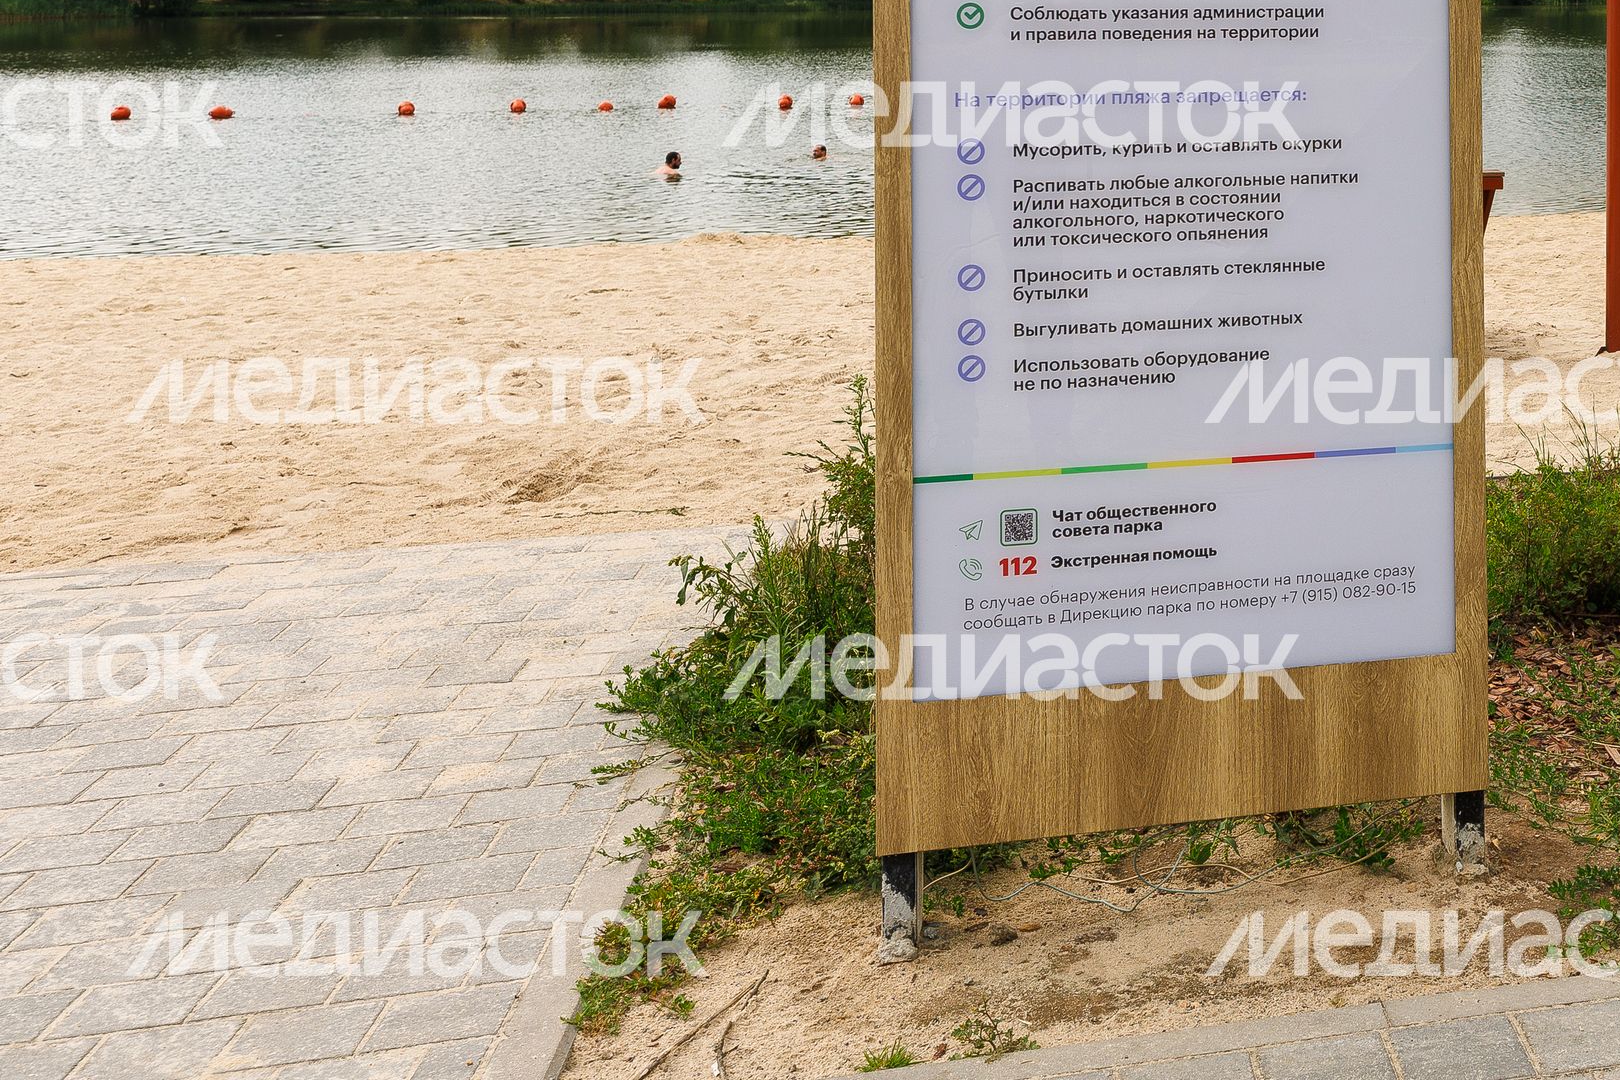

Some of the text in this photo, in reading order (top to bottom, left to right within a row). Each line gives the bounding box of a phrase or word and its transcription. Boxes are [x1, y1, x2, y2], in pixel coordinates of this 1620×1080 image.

[1010, 5, 1325, 23] Соблюдать указания администрации
[1010, 27, 1319, 44] и правила поведения на территории
[954, 89, 1307, 111] На территории пляжа запрещается:
[1013, 138, 1342, 161] Мусорить, курить и оставлять окурки
[1013, 172, 1359, 194] Распивать любые алкогольные напитки
[1013, 192, 1281, 214] и/или находиться в состоянии
[1012, 209, 1285, 230] алкогольного, наркотического
[1013, 227, 1268, 248] или токсического опьянения
[1013, 260, 1326, 287] Приносить и оставлять стеклянные
[1012, 285, 1089, 305] бутылки
[1013, 313, 1304, 340] Выгуливать домашних животных
[1013, 349, 1270, 374] Использовать оборудование
[1013, 372, 1176, 392] не по назначению
[1052, 501, 1217, 523] Чат общественного
[1051, 520, 1163, 539] совета парка
[998, 555, 1038, 577] 112
[1050, 547, 1218, 569] Экстренная помощь
[964, 565, 1416, 612] В случае обнаружения неисправности на площадке сразу
[963, 580, 1416, 631] сообщать в Дирекцию парка по номеру +7 (915) 082-90-15
